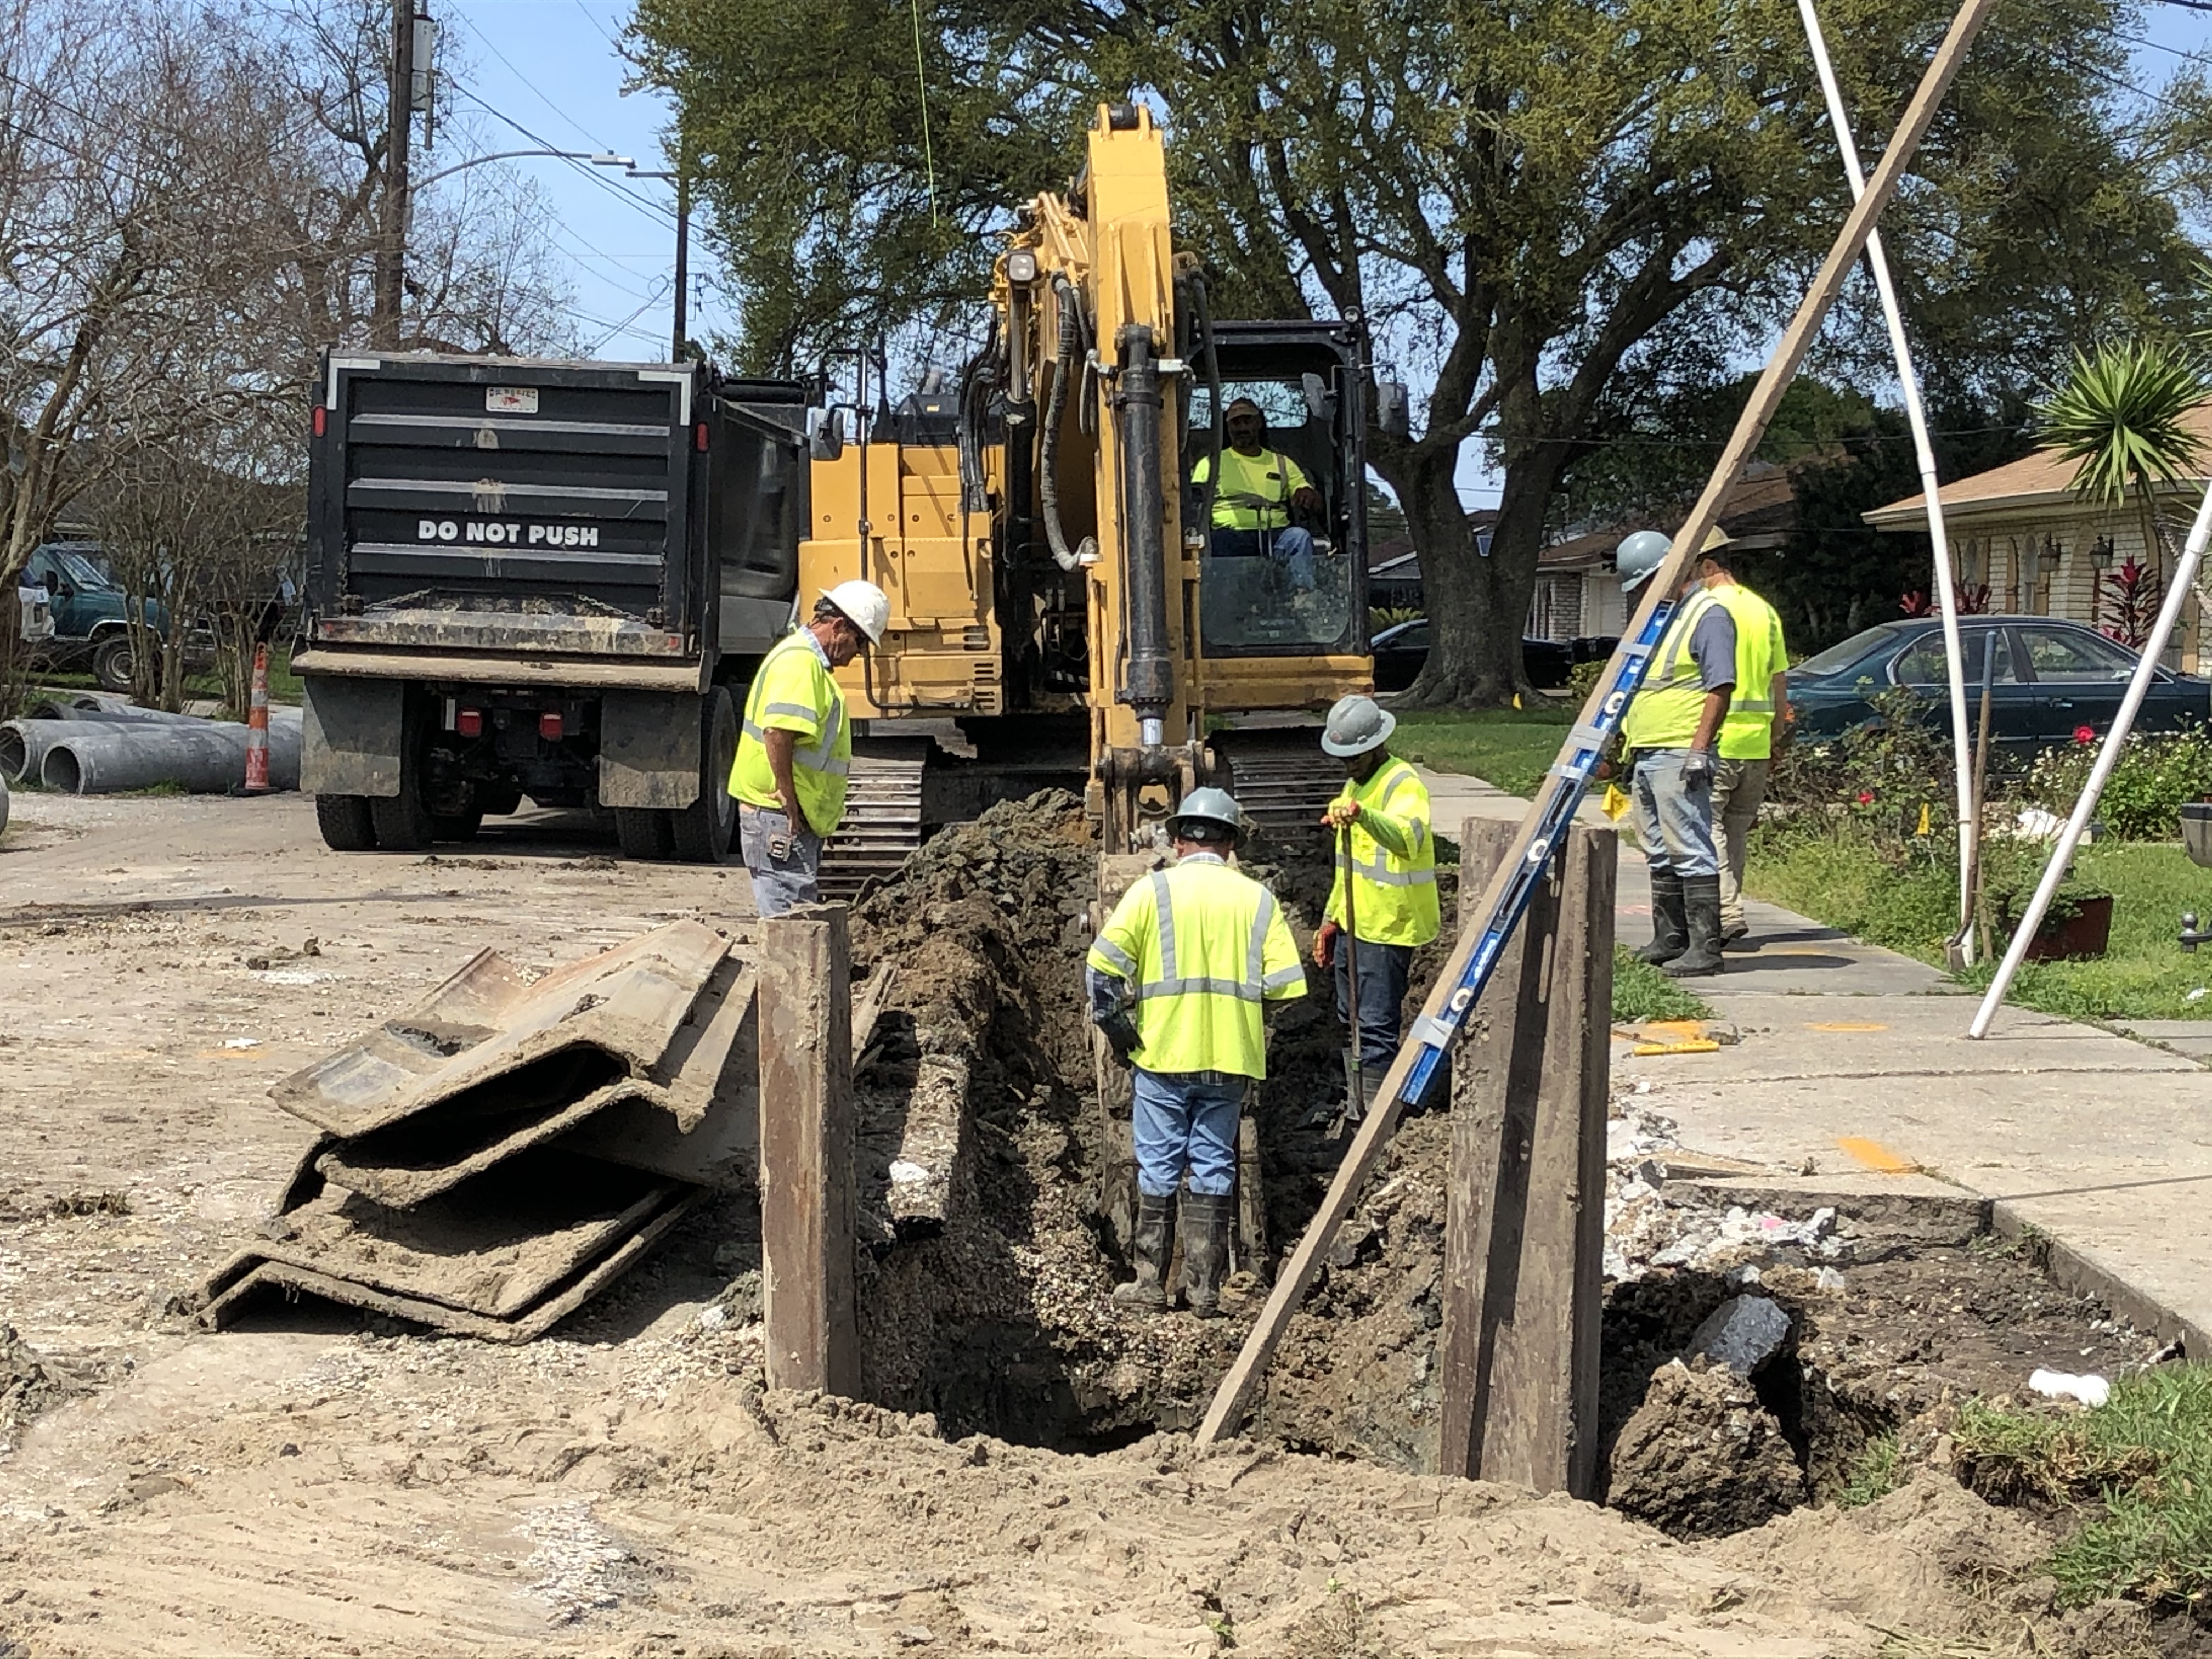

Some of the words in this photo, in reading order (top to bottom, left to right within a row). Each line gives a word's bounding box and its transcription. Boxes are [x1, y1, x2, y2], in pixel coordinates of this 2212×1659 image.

[419, 520, 458, 540] DO
[466, 522, 521, 543] NOT
[528, 525, 598, 546] PUSH
